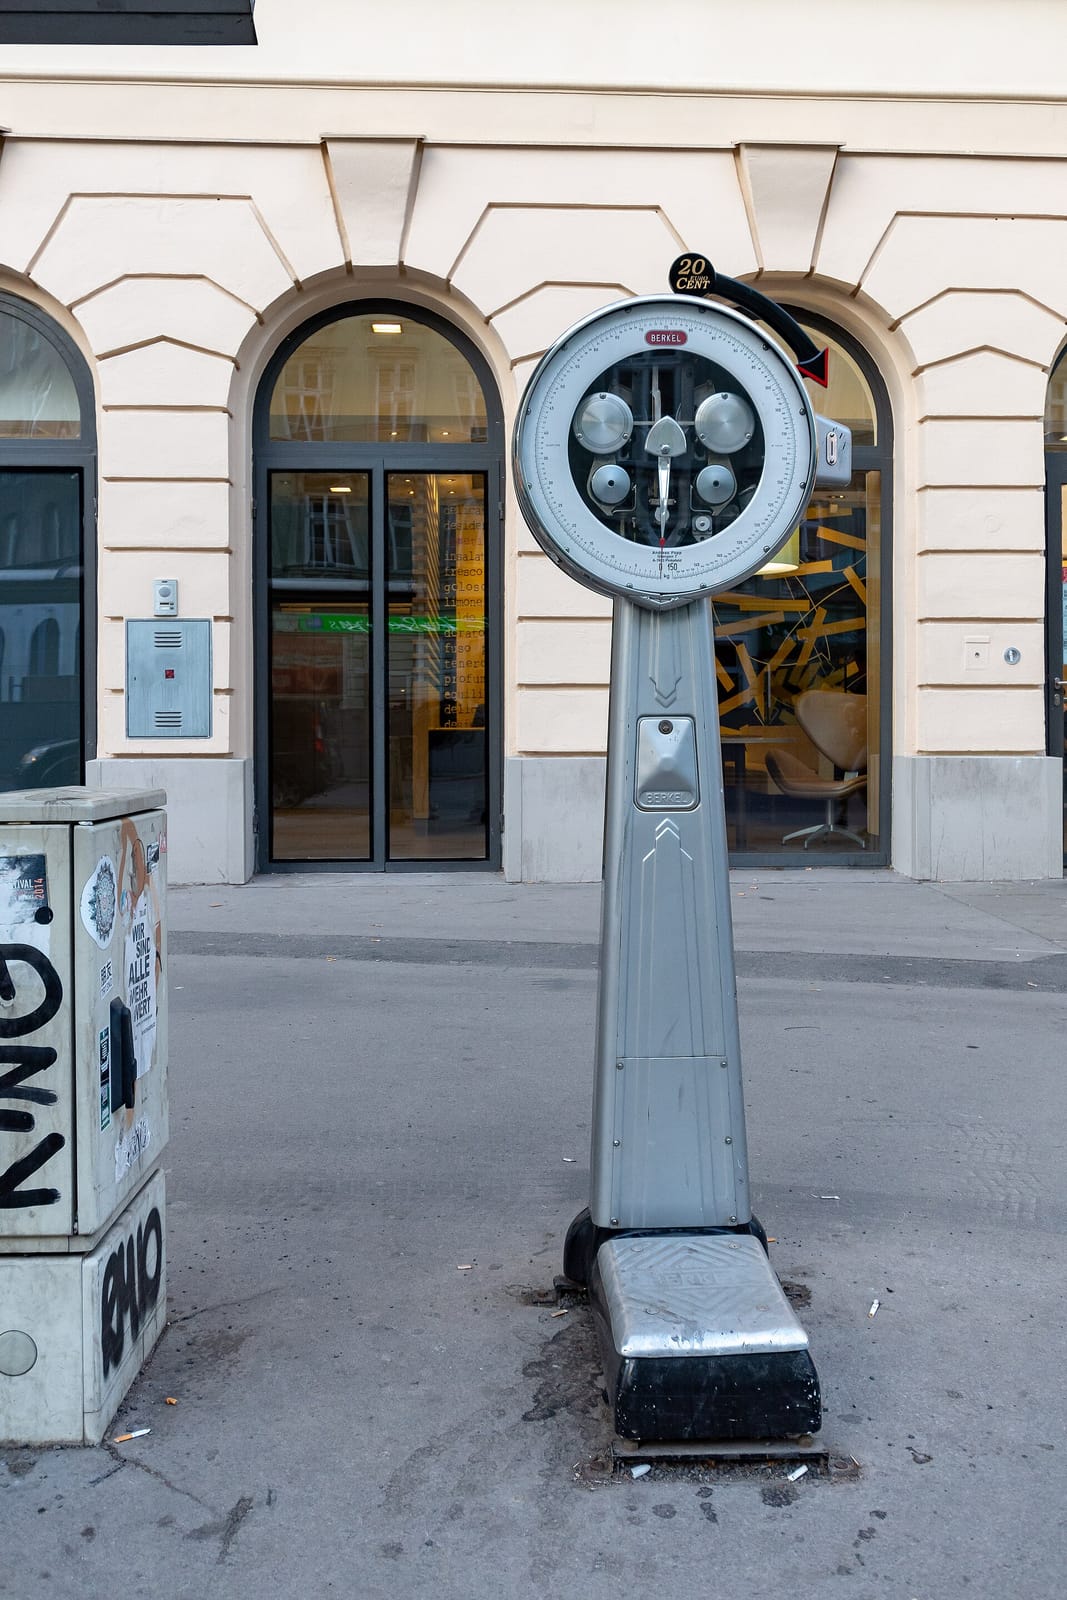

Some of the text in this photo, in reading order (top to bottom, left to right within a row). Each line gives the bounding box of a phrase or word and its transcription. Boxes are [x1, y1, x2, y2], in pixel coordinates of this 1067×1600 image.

[677, 258, 706, 275] 20
[676, 277, 710, 290] CENT
[651, 334, 682, 342] BERKEL
[444, 520, 484, 530] deside
[444, 565, 483, 577] fresco
[667, 562, 678, 571] 150
[444, 596, 482, 607] limone
[444, 643, 472, 653] fuso
[33, 878, 45, 900] 2014
[132, 922, 145, 943] WIR
[135, 937, 151, 959] SIND
[128, 954, 150, 988] ALLE
[129, 980, 148, 1007] MEHR
[133, 996, 151, 1023] WERT
